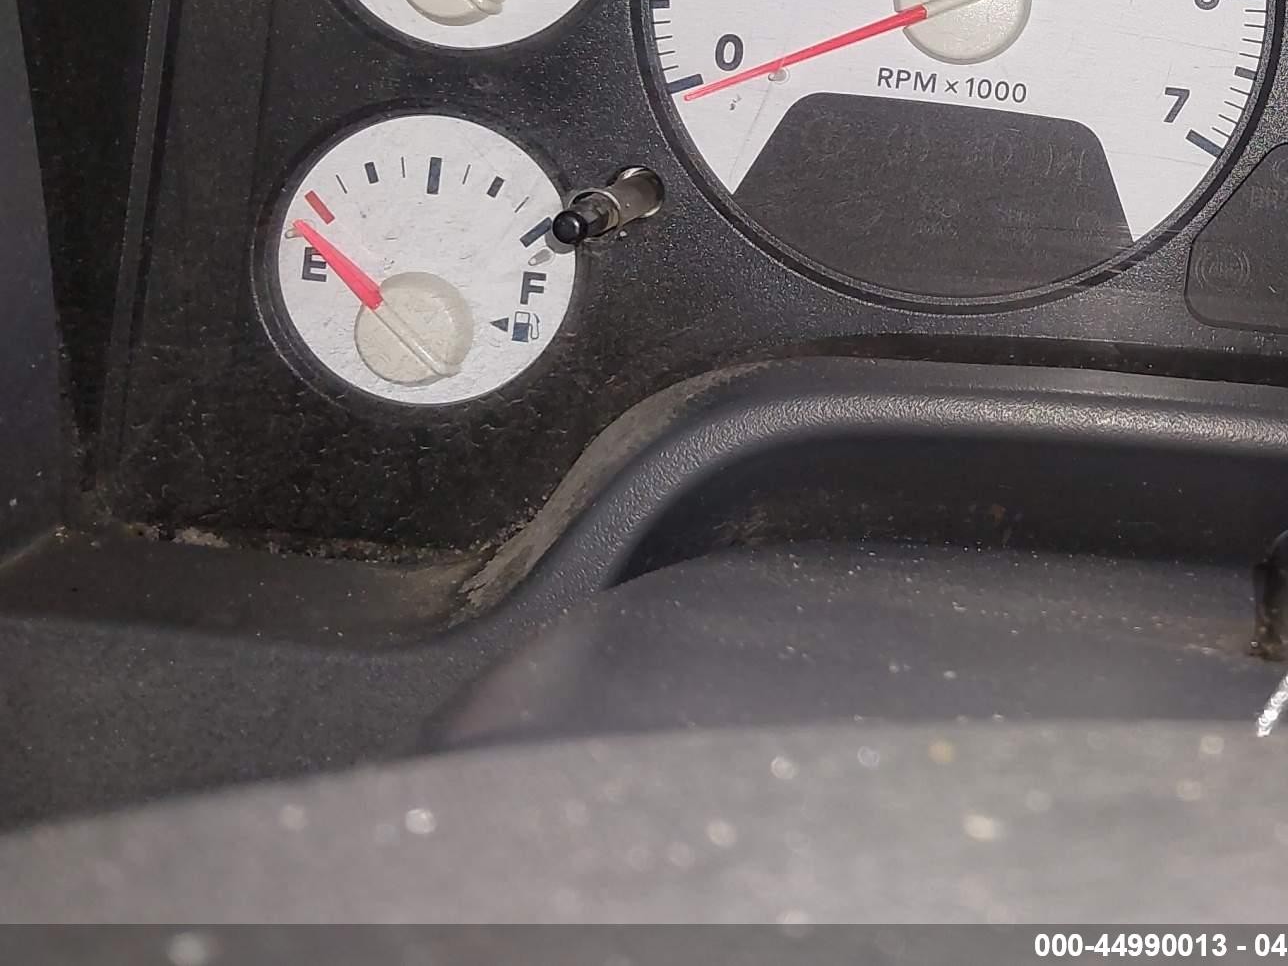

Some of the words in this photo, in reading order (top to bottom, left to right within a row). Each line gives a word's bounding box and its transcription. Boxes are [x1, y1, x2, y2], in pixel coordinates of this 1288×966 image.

[714, 34, 744, 72] 0
[877, 67, 937, 95] RPM
[1163, 87, 1190, 123] 7
[302, 247, 328, 283] E
[520, 271, 546, 305] F
